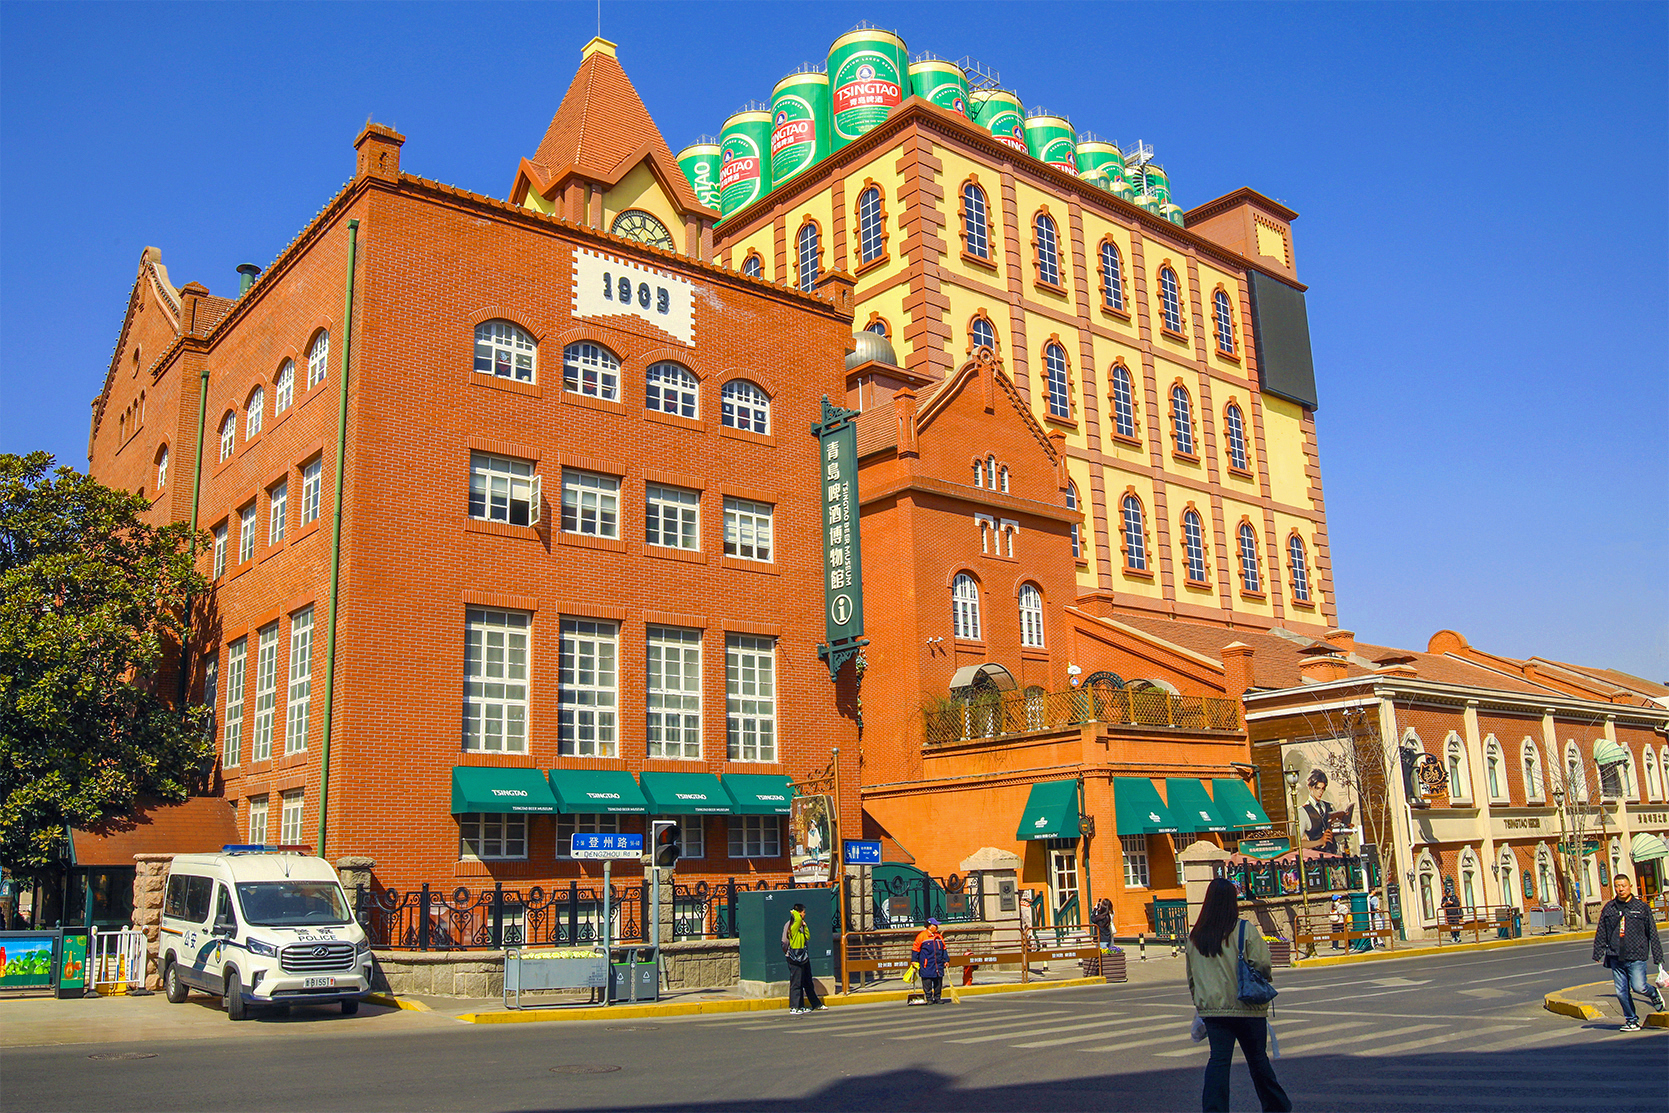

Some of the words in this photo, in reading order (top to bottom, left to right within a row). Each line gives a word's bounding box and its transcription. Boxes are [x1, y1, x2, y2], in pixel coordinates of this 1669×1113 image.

[837, 84, 898, 100] TSINGTAO
[602, 271, 670, 315] 1903
[589, 837, 627, 848] 登州路
